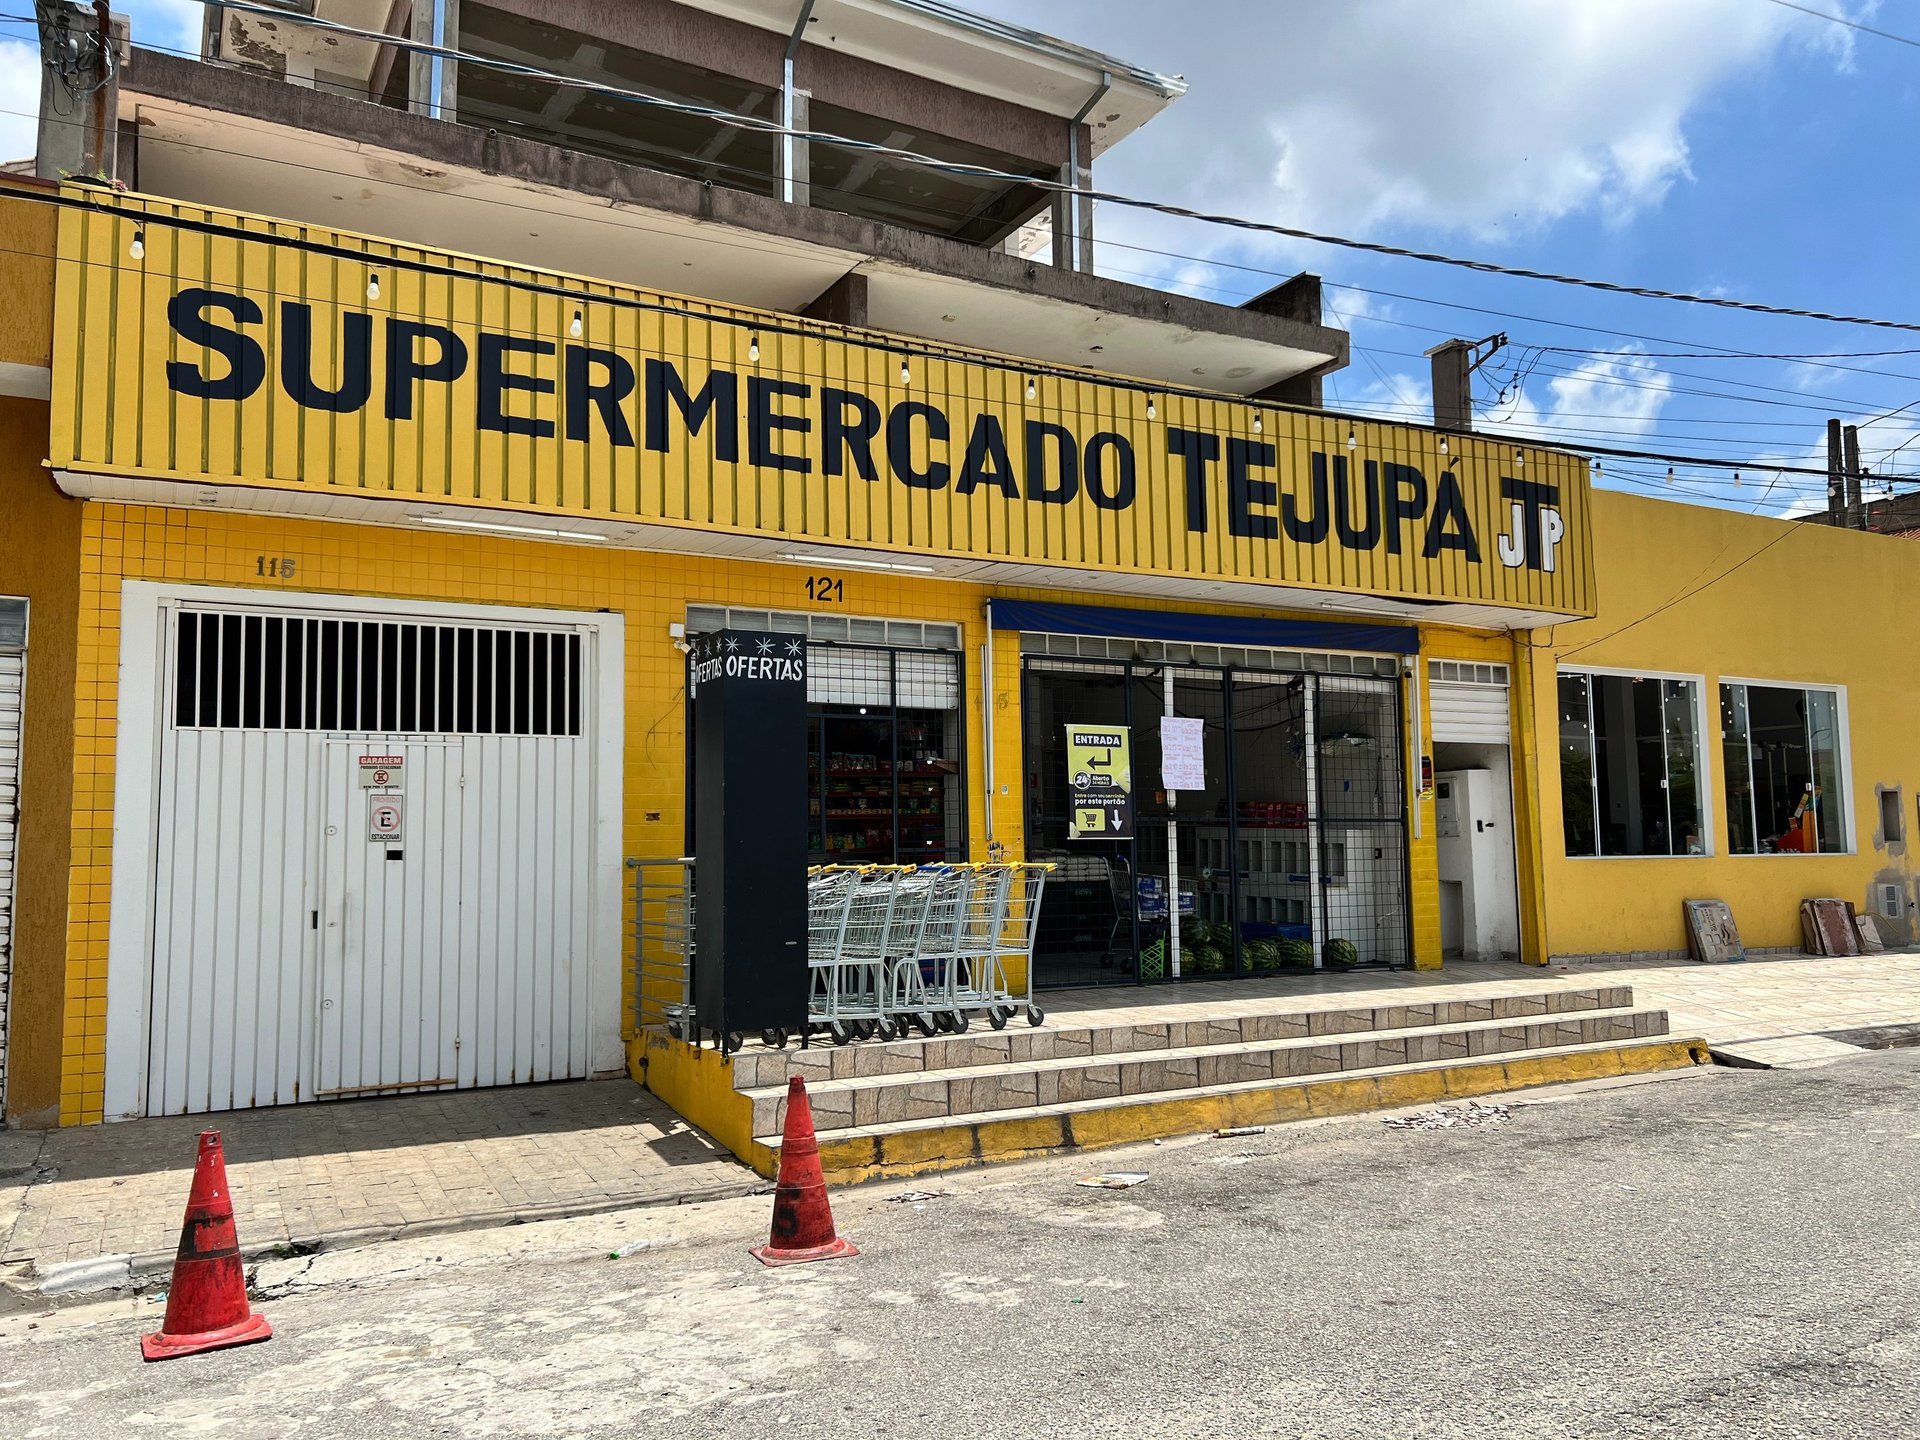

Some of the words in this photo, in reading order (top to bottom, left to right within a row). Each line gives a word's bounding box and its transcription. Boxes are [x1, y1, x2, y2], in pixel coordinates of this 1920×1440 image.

[166, 287, 1136, 511] SUPERMERCADO
[1168, 426, 1483, 564] TEJUPÁ
[256, 556, 296, 579] 115
[805, 576, 844, 603] 121
[725, 655, 803, 682] OFERTAS
[1075, 735, 1120, 745] ENTRADA
[381, 811, 391, 827] E
